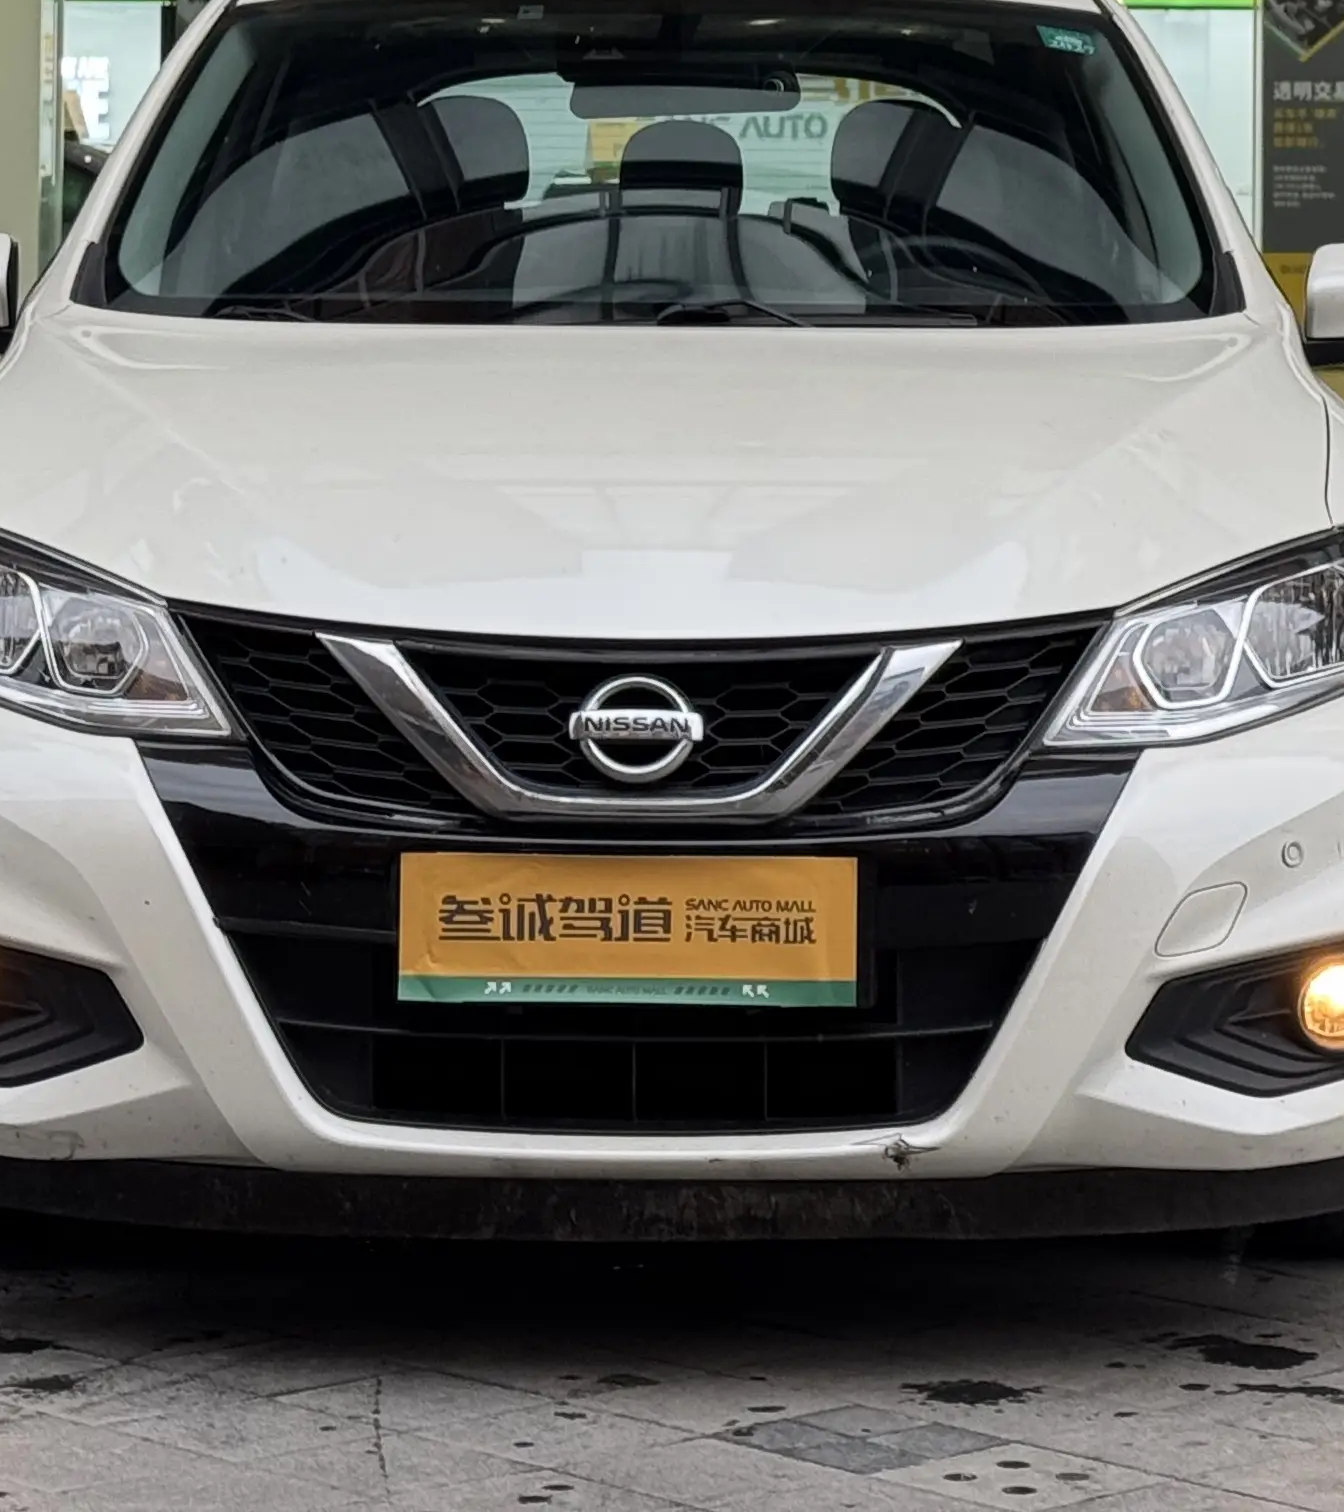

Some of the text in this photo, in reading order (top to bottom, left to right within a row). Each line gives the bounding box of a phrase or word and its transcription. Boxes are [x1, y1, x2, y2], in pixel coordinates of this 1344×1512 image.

[583, 716, 690, 733] NISSAN
[684, 898, 817, 914] SANC AUTO MALL
[438, 893, 673, 943] 叁诚驾道
[684, 915, 818, 945] 汽车商城
